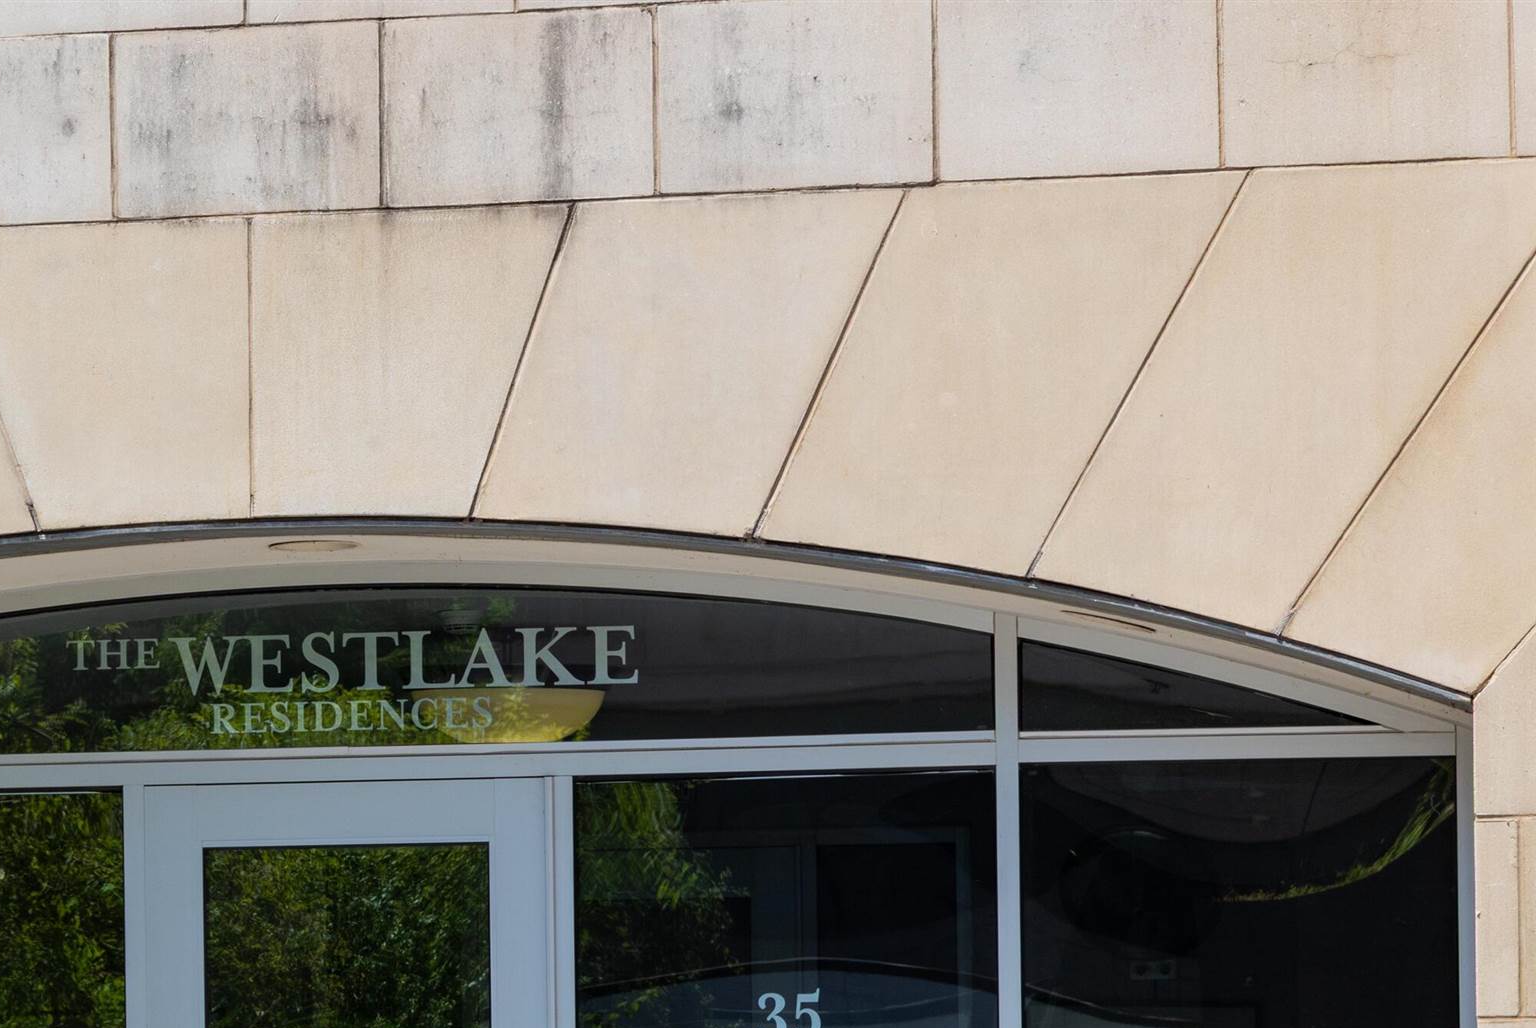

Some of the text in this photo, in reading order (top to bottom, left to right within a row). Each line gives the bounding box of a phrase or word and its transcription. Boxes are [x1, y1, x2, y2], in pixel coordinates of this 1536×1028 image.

[66, 625, 638, 697] THE WESTLAKE
[211, 696, 493, 735] RESIDENCES
